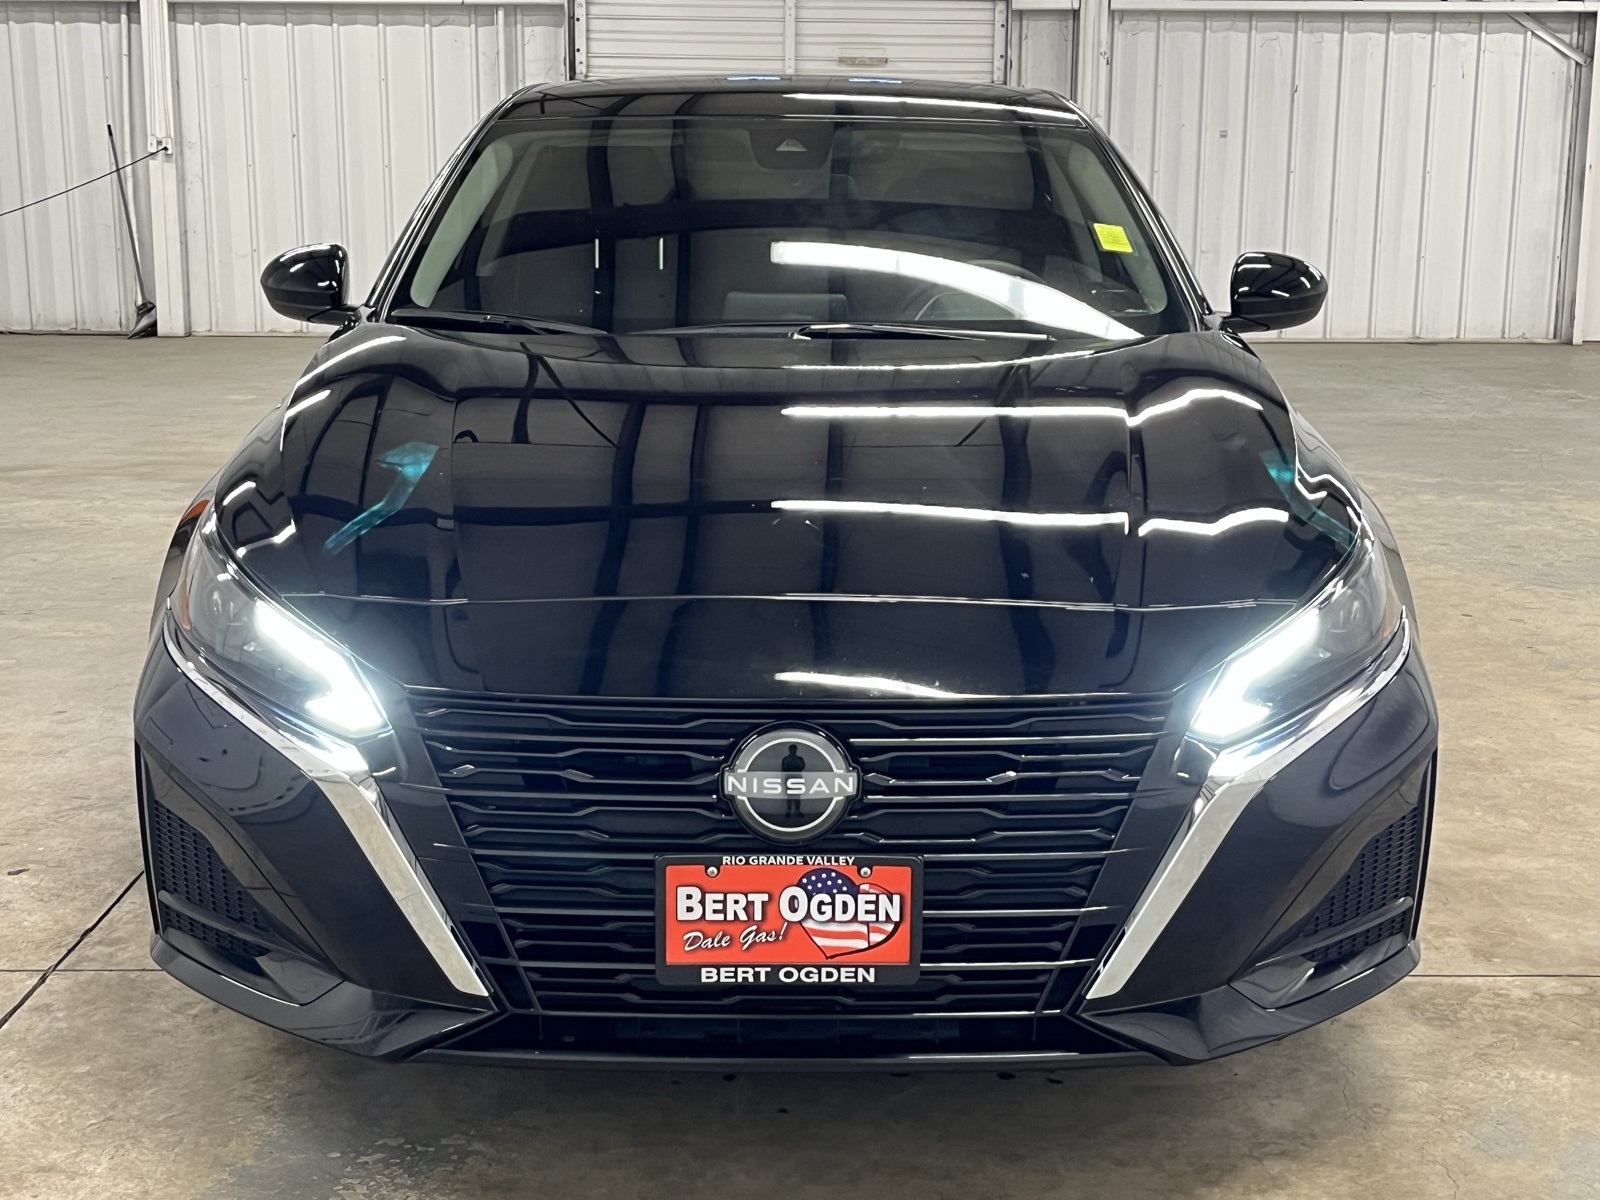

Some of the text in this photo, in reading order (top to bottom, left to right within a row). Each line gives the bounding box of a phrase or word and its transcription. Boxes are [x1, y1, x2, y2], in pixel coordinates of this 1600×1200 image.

[727, 776, 853, 794] NISSAN
[722, 856, 855, 866] RIO GRANDE VALLEY
[676, 885, 900, 922] BERT OGDEN
[683, 921, 788, 951] Dale Gas!
[701, 967, 875, 983] BERT OGDEN
